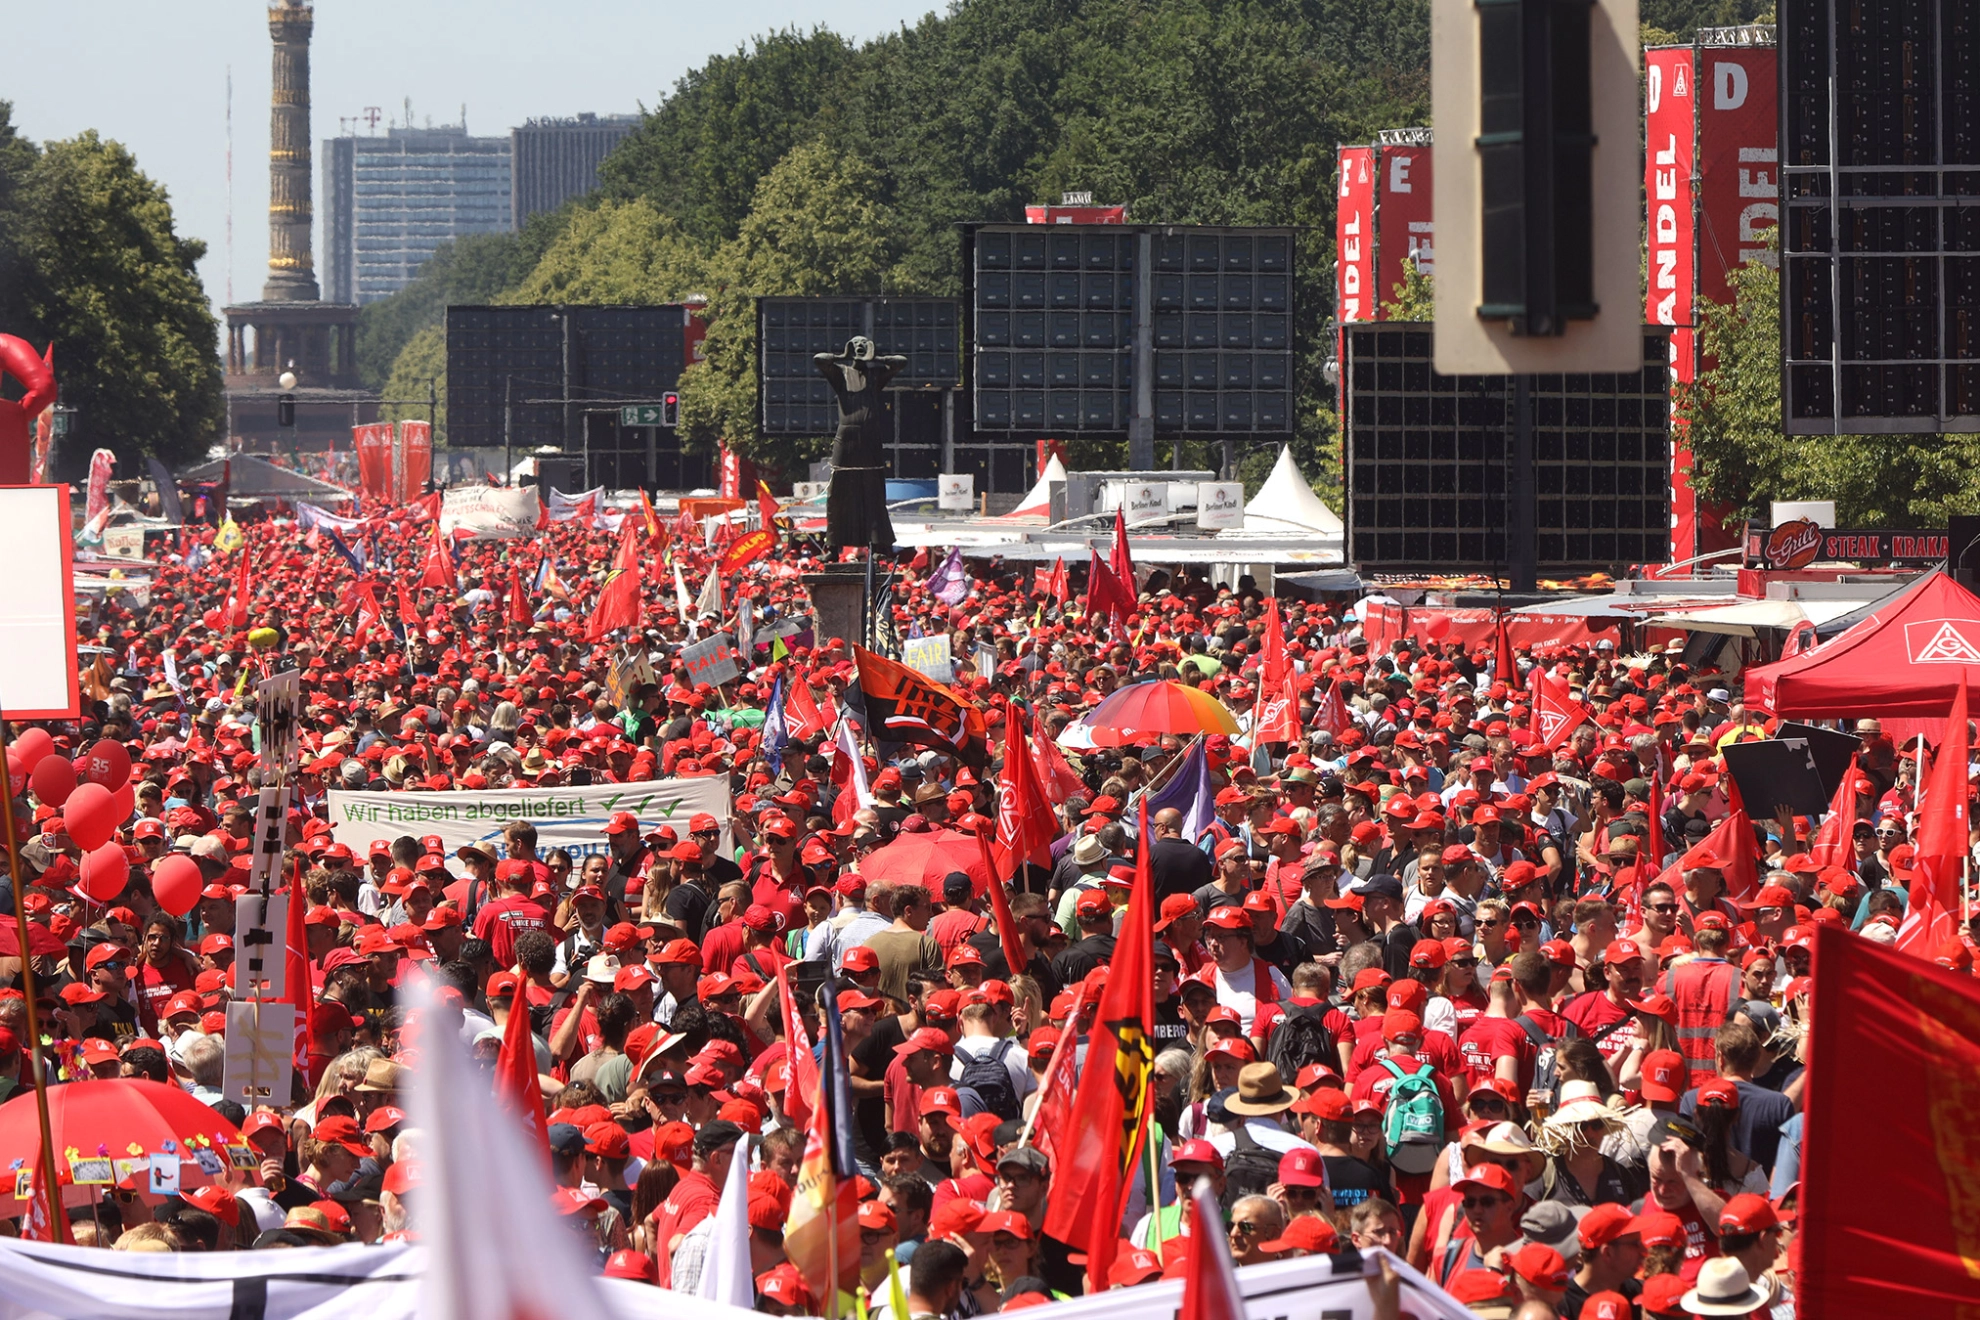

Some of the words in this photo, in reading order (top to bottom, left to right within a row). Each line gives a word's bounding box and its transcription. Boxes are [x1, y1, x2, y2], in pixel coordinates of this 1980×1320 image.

[1714, 62, 1749, 110] D
[1390, 156, 1412, 193] E
[1769, 525, 1816, 567] Grill
[1826, 536, 1881, 559] STEAK
[686, 645, 730, 676] FAIR
[907, 643, 949, 670] FAIR!
[91, 757, 109, 773] 35
[343, 803, 381, 822] Wir
[388, 802, 458, 822] haben
[465, 797, 586, 822] abgeliefert
